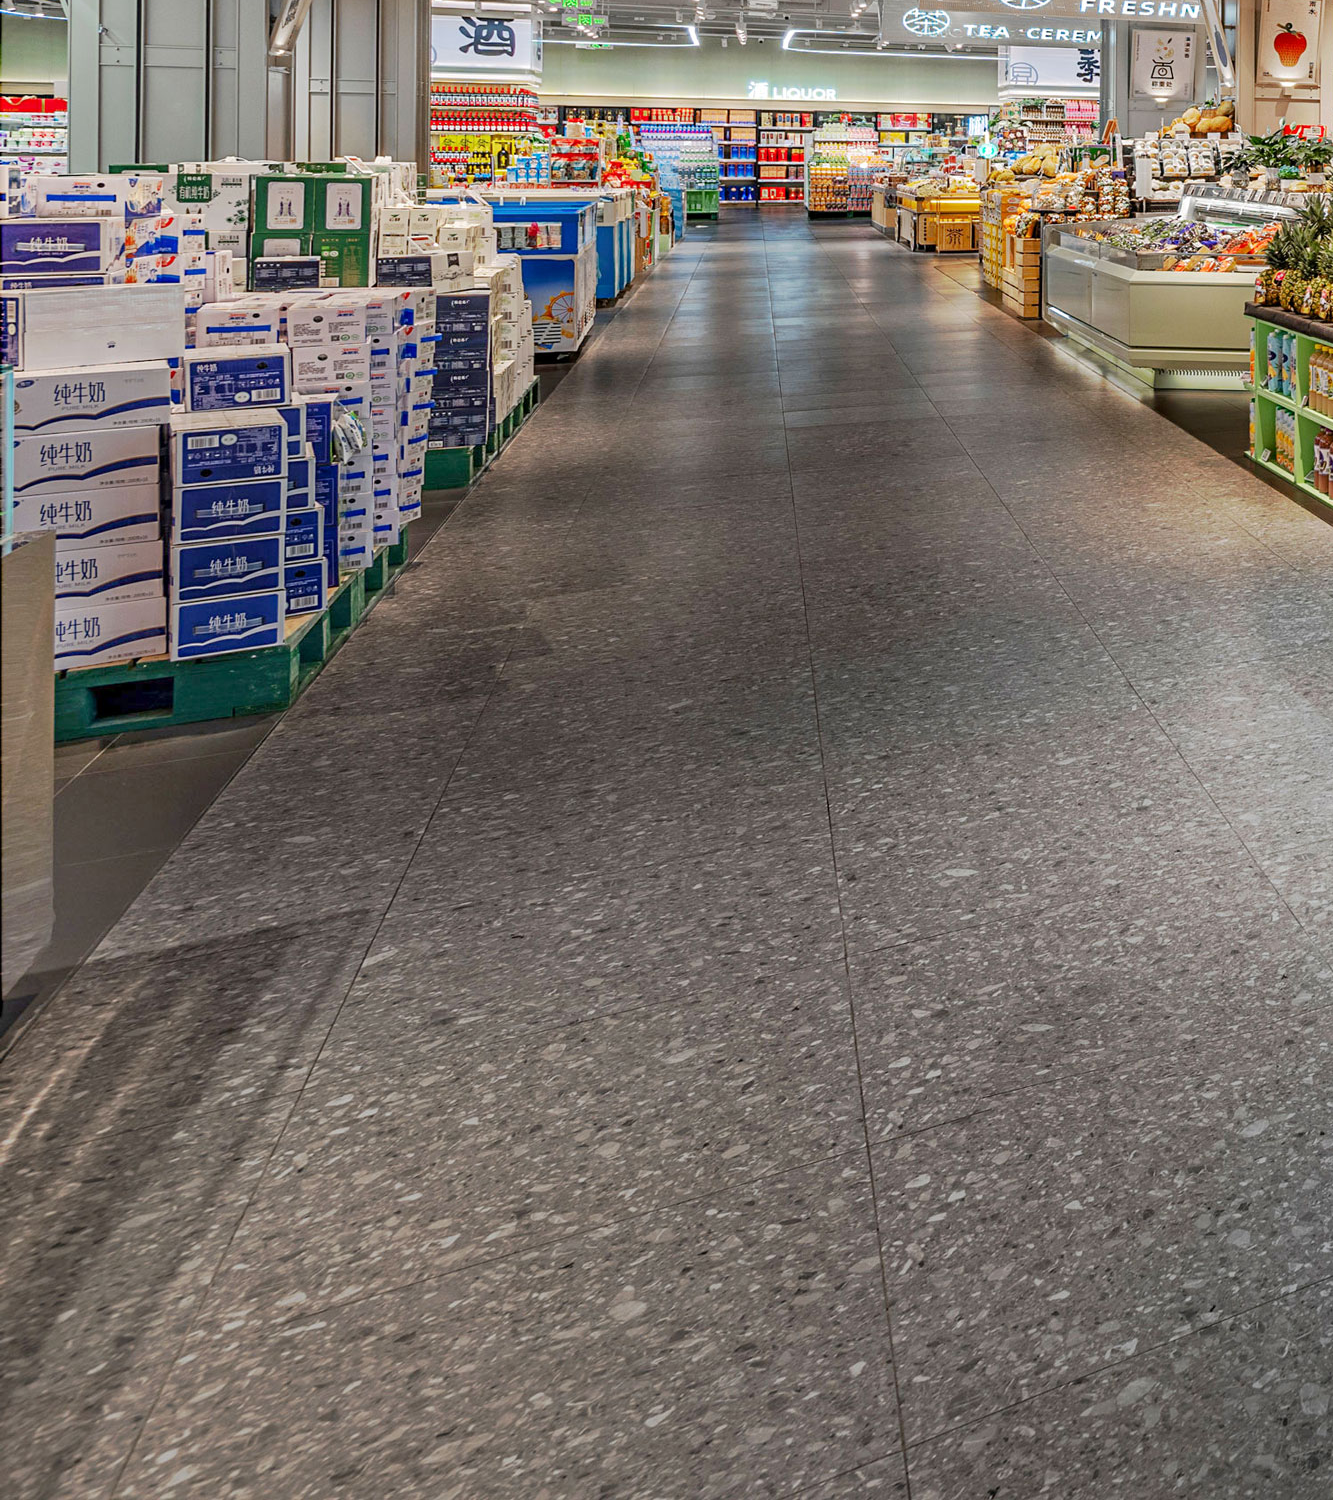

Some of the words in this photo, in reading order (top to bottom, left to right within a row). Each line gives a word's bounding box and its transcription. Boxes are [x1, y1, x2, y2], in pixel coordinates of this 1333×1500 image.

[458, 17, 516, 57] 酒
[963, 24, 1010, 39] TEA
[772, 86, 837, 101] LIQUOR
[54, 381, 106, 406] 纯牛奶
[40, 441, 92, 467] 纯牛奶
[40, 500, 92, 526] 纯牛奶
[211, 498, 250, 517] 纯牛奶
[209, 556, 249, 574] 纯牛奶
[208, 612, 247, 631] 纯牛奶
